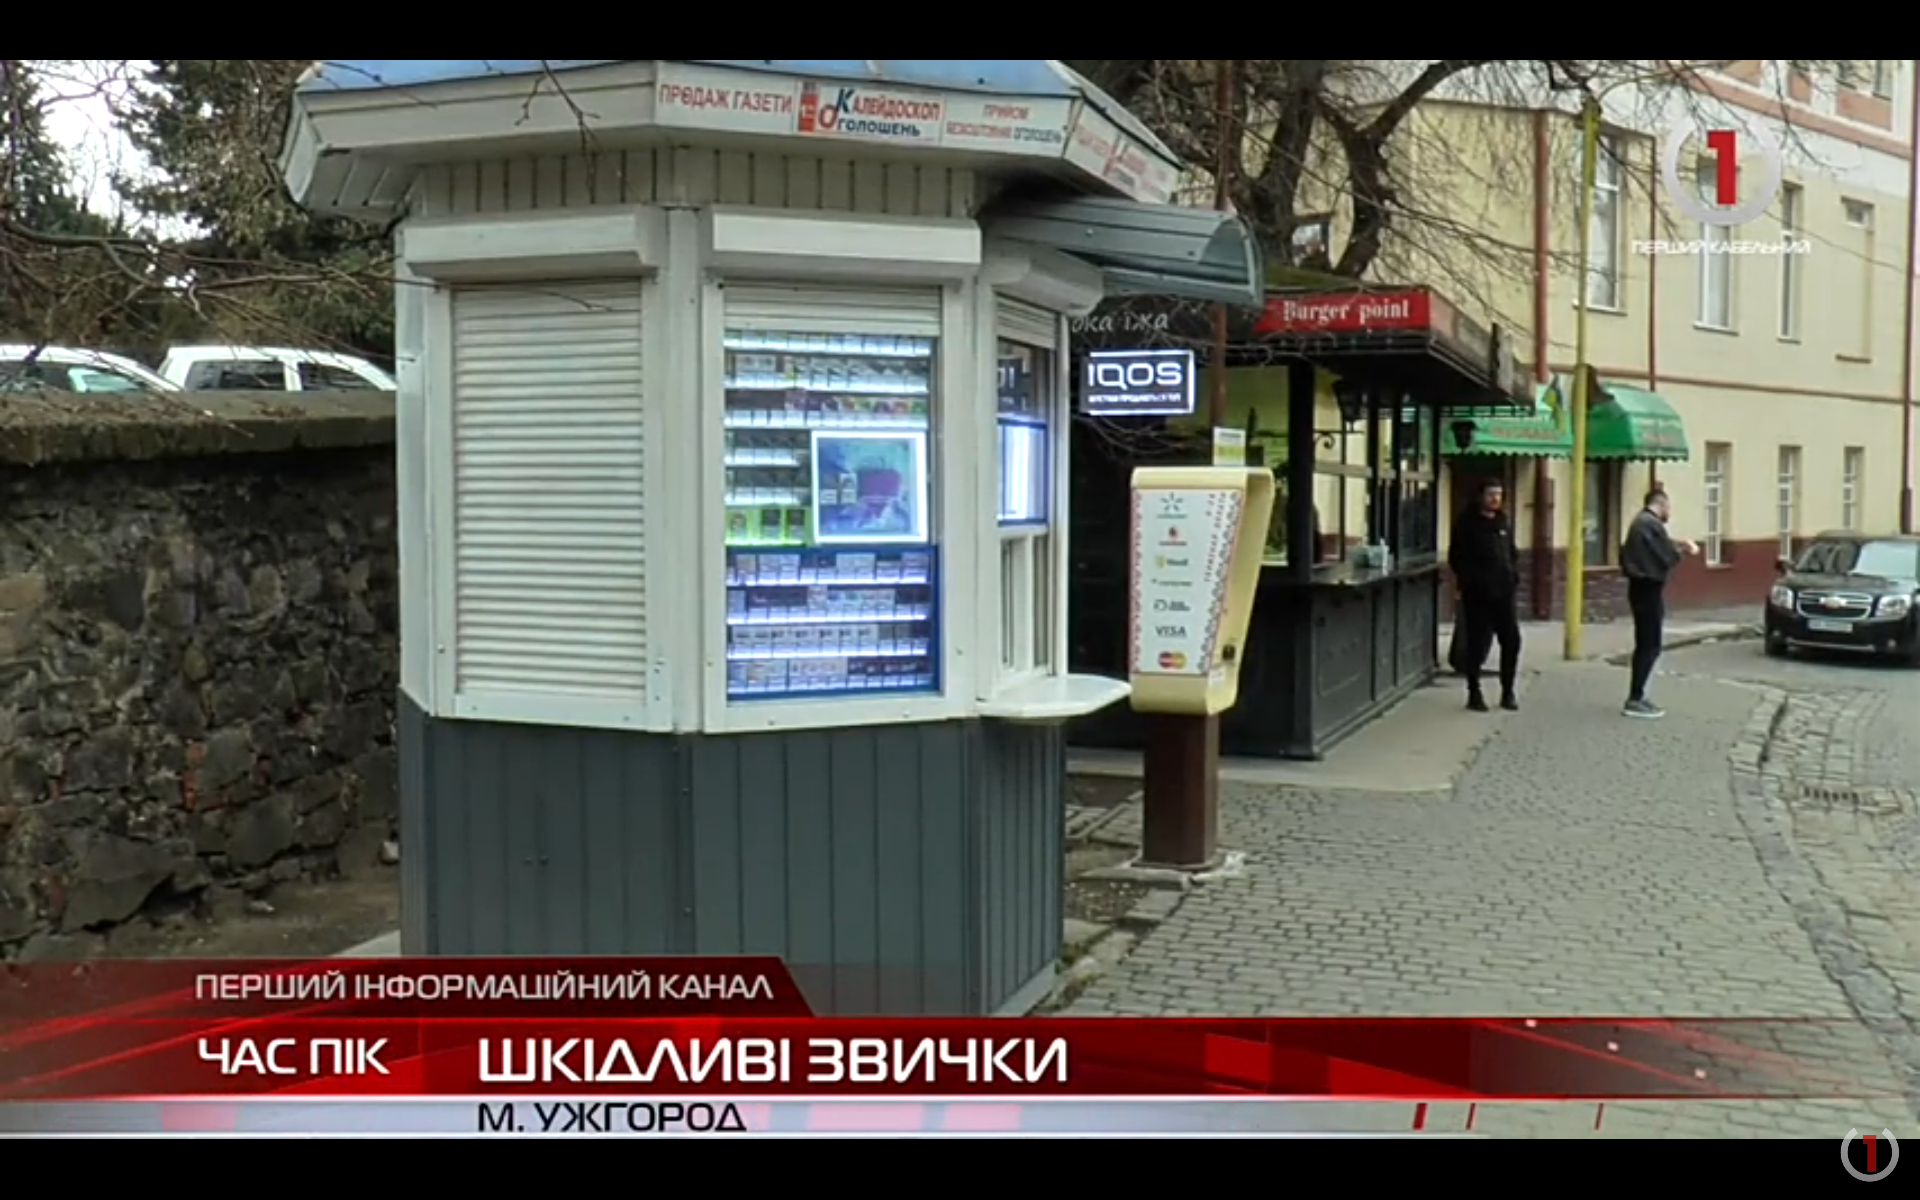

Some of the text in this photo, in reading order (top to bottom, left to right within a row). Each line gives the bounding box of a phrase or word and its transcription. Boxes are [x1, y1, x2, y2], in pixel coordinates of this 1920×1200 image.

[660, 84, 730, 110] ПРОДАЖ
[732, 90, 793, 114] ГАЗЕТИ
[1283, 299, 1409, 327] Burger point
[1088, 362, 1183, 391] IQOS
[1155, 625, 1187, 638] VISA
